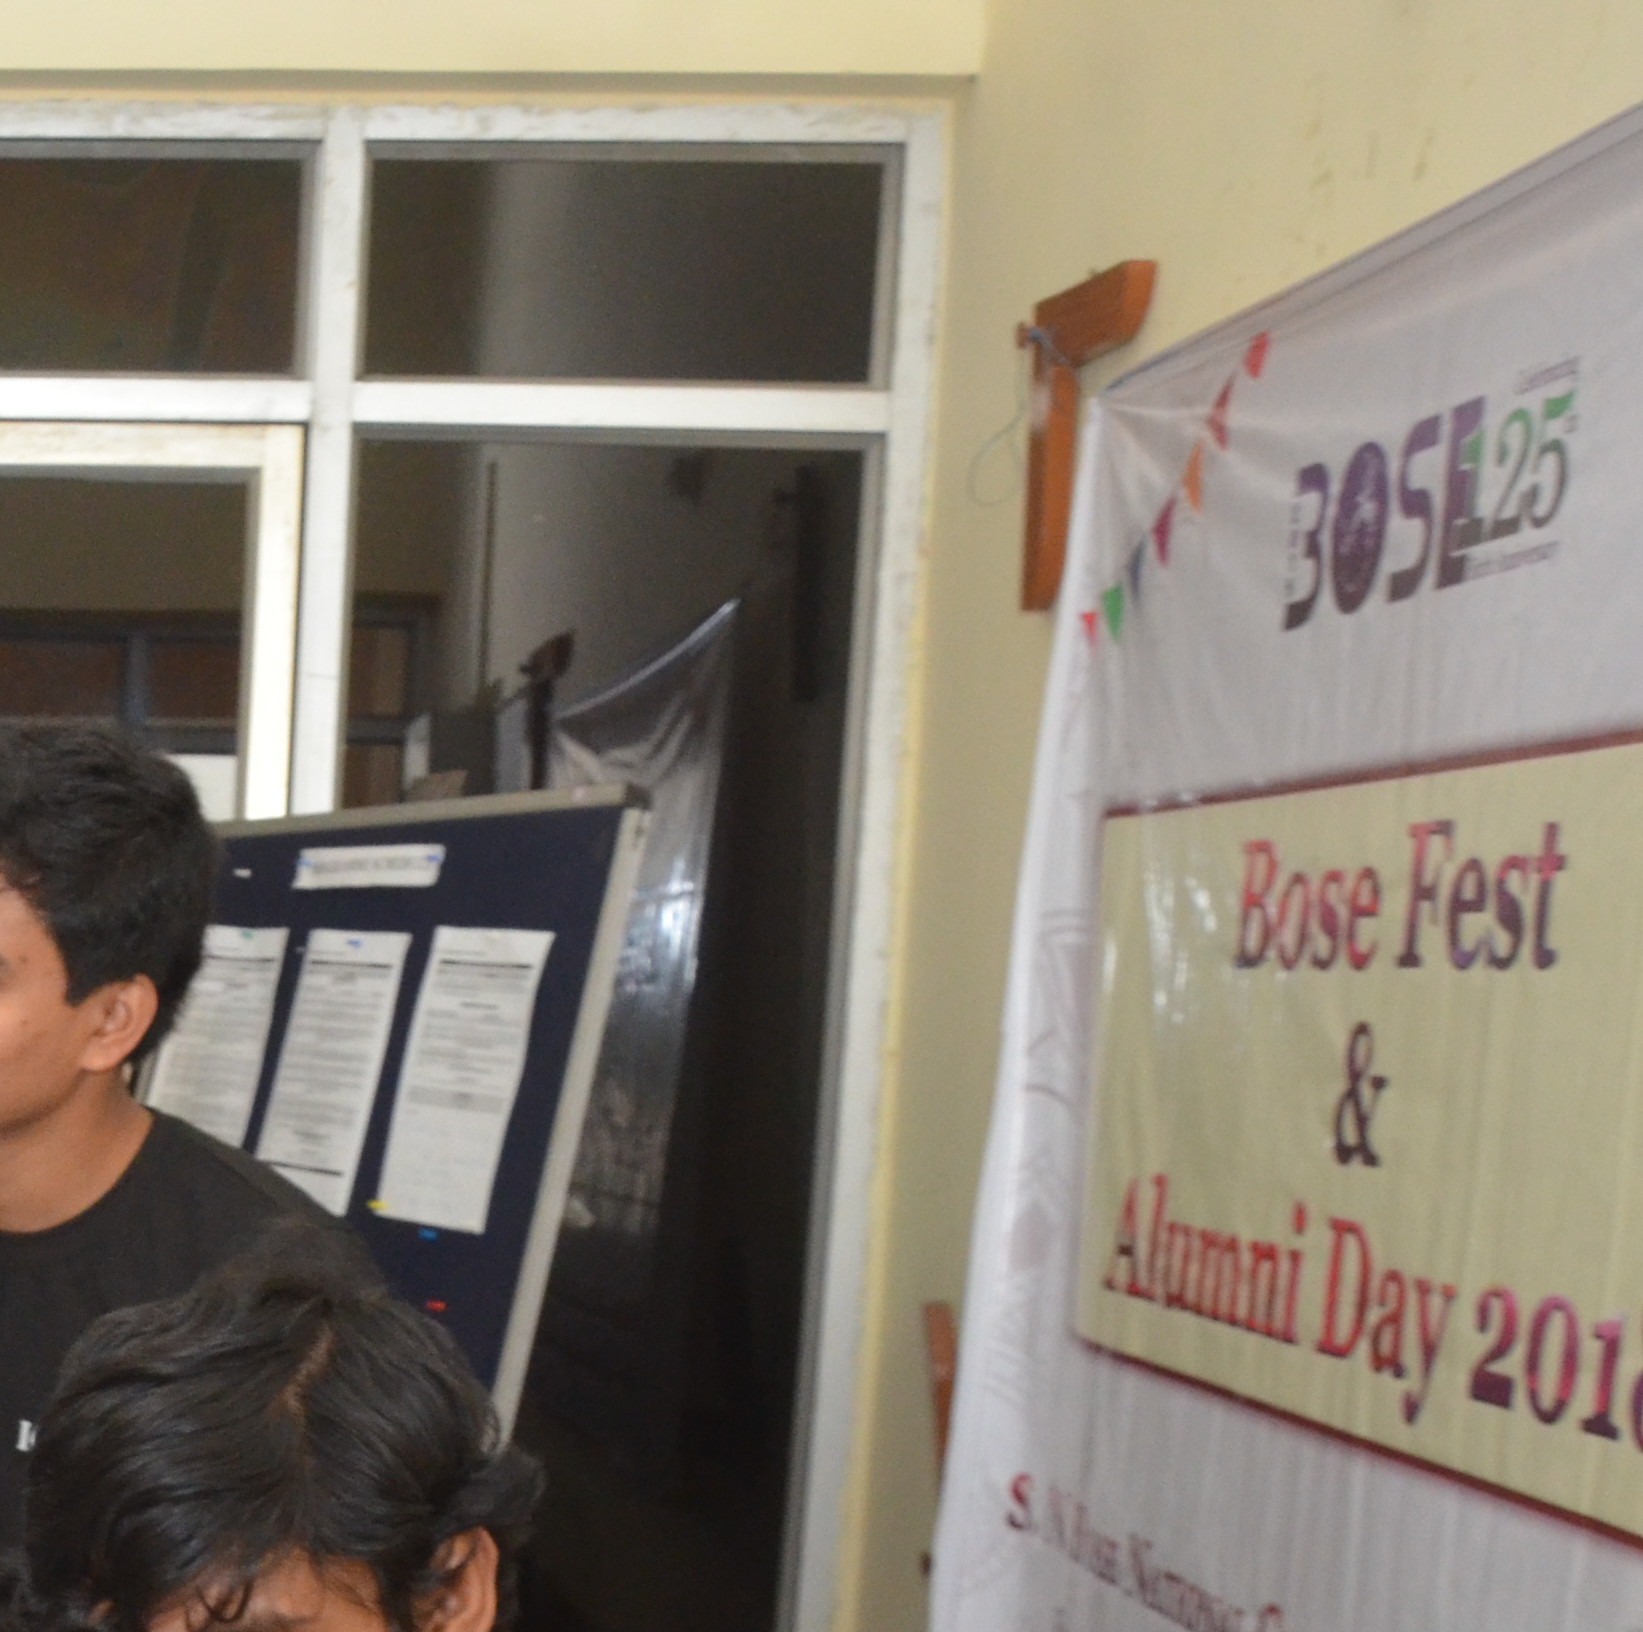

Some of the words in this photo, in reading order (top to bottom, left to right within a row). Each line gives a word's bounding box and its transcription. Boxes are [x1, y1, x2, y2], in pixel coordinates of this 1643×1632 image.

[1234, 839, 1381, 970] Bose
[1396, 818, 1569, 970] Fest
[1333, 1020, 1390, 1167] &
[1103, 1173, 1307, 1346] Alumni
[1316, 1217, 1457, 1426] Day
[1468, 1282, 1643, 1455] 201
